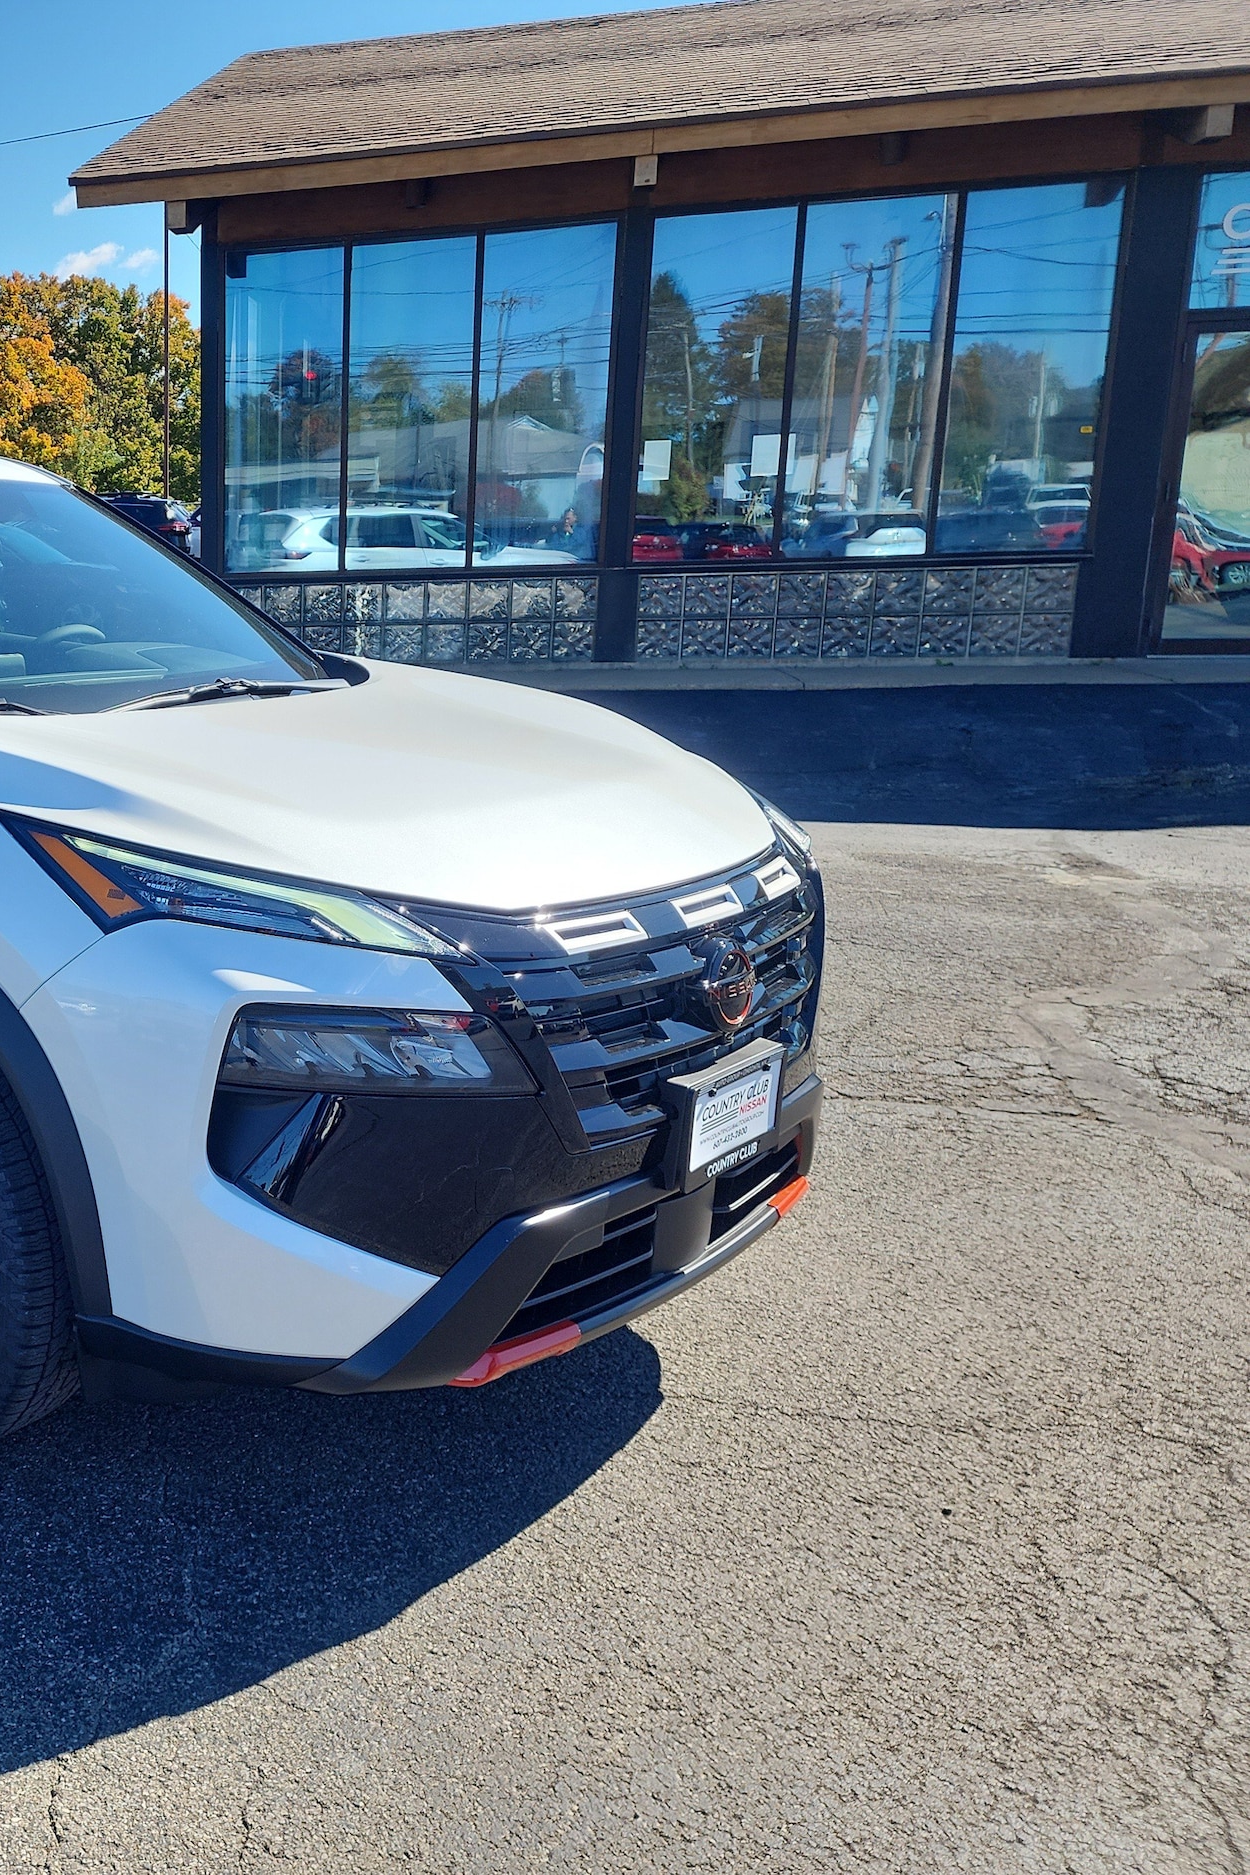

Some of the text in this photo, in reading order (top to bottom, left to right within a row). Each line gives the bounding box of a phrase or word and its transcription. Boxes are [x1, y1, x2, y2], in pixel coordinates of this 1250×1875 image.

[702, 1078, 769, 1122] COUNTRY CLUB
[739, 1095, 767, 1116] NISSAN
[707, 1141, 758, 1178] COUNTRY CLUB
